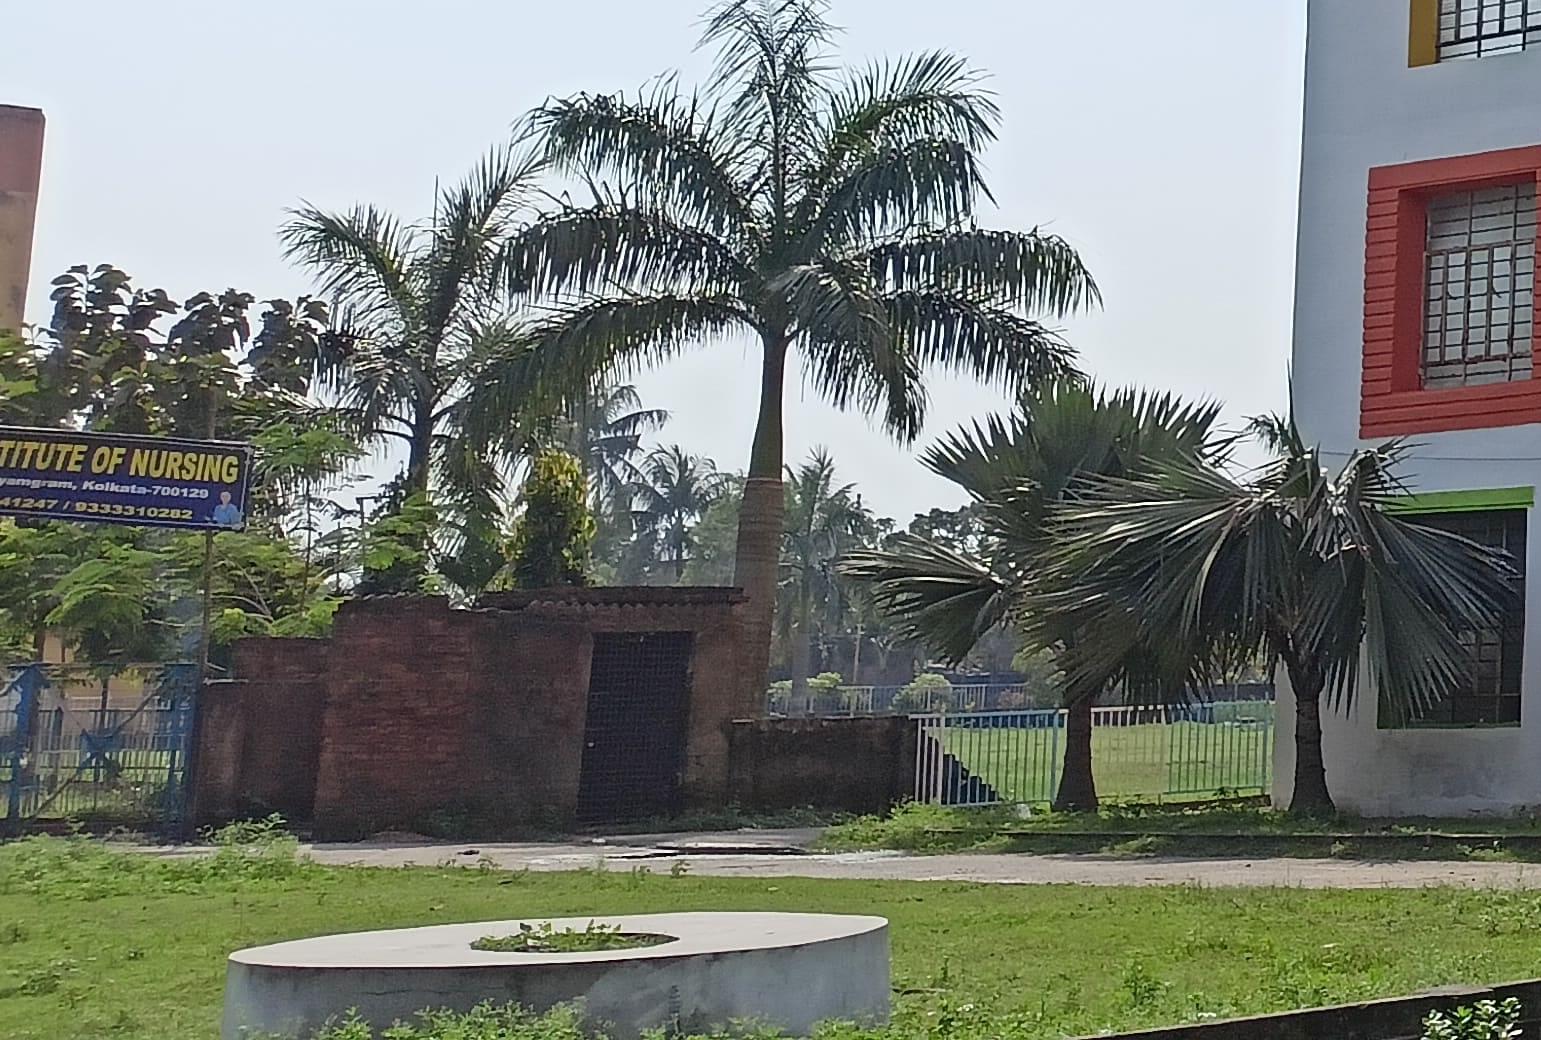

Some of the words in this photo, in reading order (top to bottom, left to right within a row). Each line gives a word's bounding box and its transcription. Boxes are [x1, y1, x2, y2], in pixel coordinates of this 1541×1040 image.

[0, 440, 88, 472] TITUTE
[91, 446, 127, 475] OF
[129, 449, 239, 484] NURSING
[82, 480, 209, 499] Kolkata-700129
